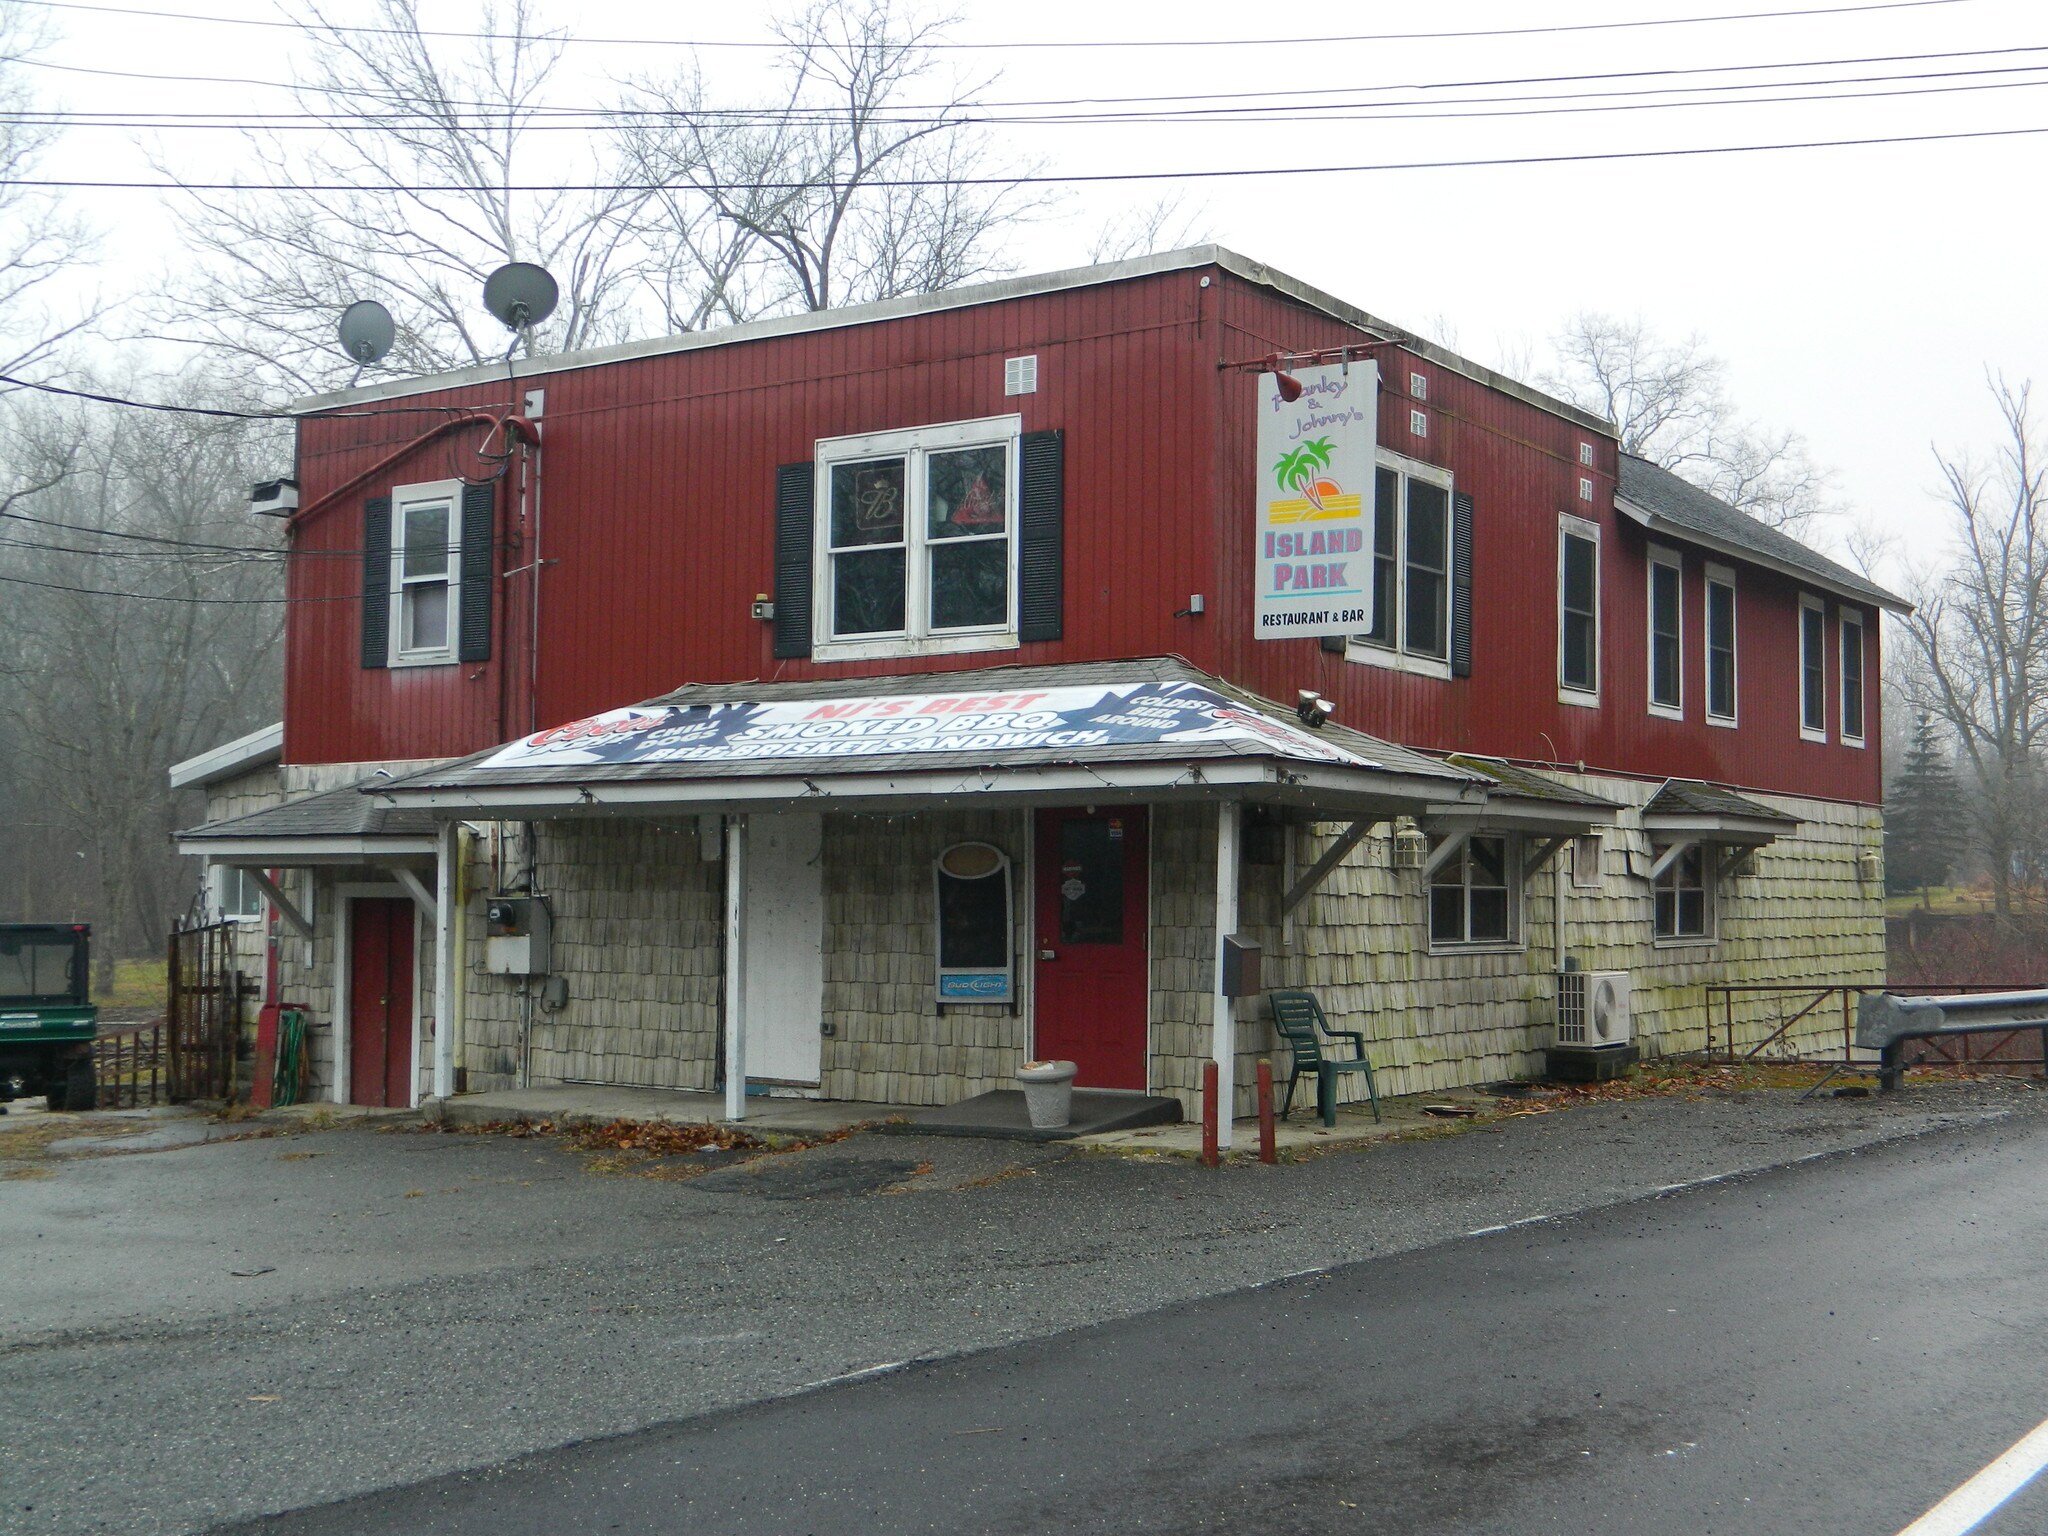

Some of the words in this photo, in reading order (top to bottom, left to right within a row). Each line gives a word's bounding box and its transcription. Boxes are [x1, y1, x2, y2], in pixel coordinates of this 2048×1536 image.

[1308, 398, 1323, 410] &
[1289, 406, 1364, 440] Johnny's
[1263, 527, 1363, 559] ISLAND
[1273, 562, 1349, 592] PARK
[1262, 611, 1329, 627] RESTAURANT
[1332, 612, 1339, 623] &
[1342, 608, 1364, 623] BAR
[804, 701, 914, 720] NJ'S
[916, 693, 1049, 715] BEST
[1126, 706, 1180, 719] BEER
[1129, 695, 1219, 711] COLDEST
[647, 719, 722, 739] CHILI
[732, 717, 937, 741] SMOKED
[936, 711, 1060, 732] BBQ
[1088, 713, 1181, 729] AROUND
[634, 728, 720, 751] DOGS
[639, 745, 731, 761] BEEF
[726, 739, 882, 758] BRISKET
[880, 729, 1110, 751] SANDWICH
